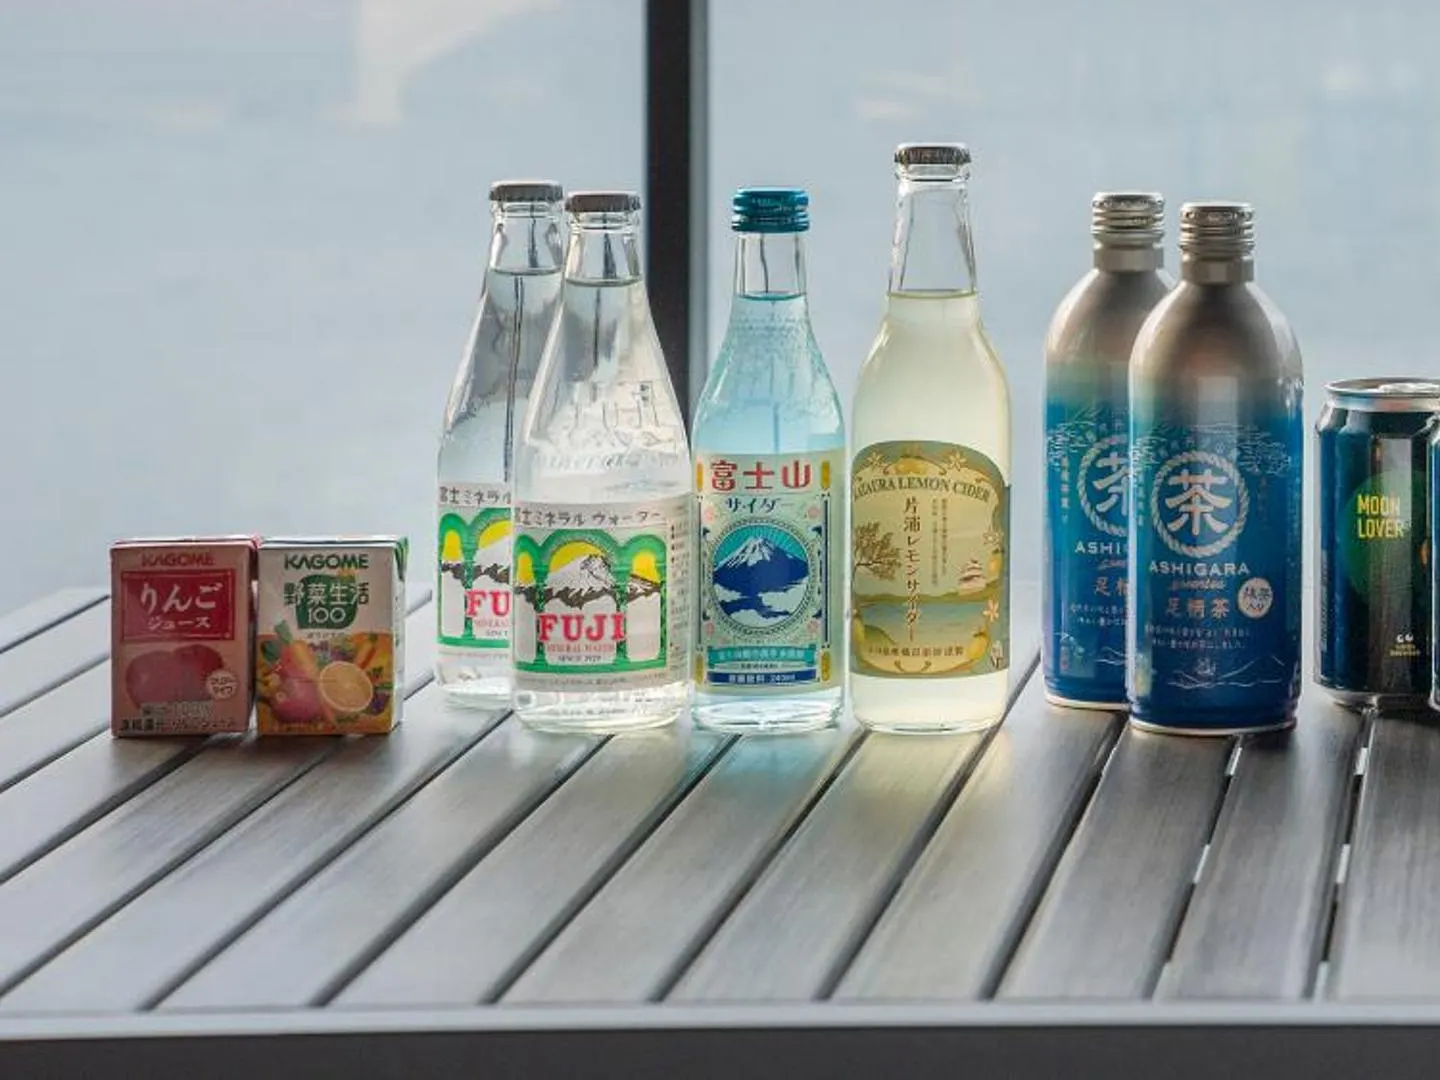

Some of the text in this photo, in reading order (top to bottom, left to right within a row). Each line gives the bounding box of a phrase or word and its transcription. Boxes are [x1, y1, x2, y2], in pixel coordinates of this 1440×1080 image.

[711, 459, 812, 492] 富士山
[898, 476, 950, 492] LEMON
[953, 481, 991, 503] CIDER
[725, 497, 798, 514] サイダー
[1165, 469, 1232, 536] 茶
[1357, 493, 1400, 516] MOON
[1358, 518, 1405, 539] LOVER
[141, 552, 215, 567] KAGOME
[284, 553, 370, 570] KAGOME
[903, 495, 922, 643] 片浦レモンサイダー
[1148, 560, 1249, 577] ASHIGARA
[140, 582, 224, 616] りんご
[283, 581, 370, 606] 野菜生活
[307, 607, 346, 624] 100
[1165, 597, 1231, 619] 足柄茶
[147, 616, 211, 631] ジュース
[538, 613, 626, 642] FUJI
